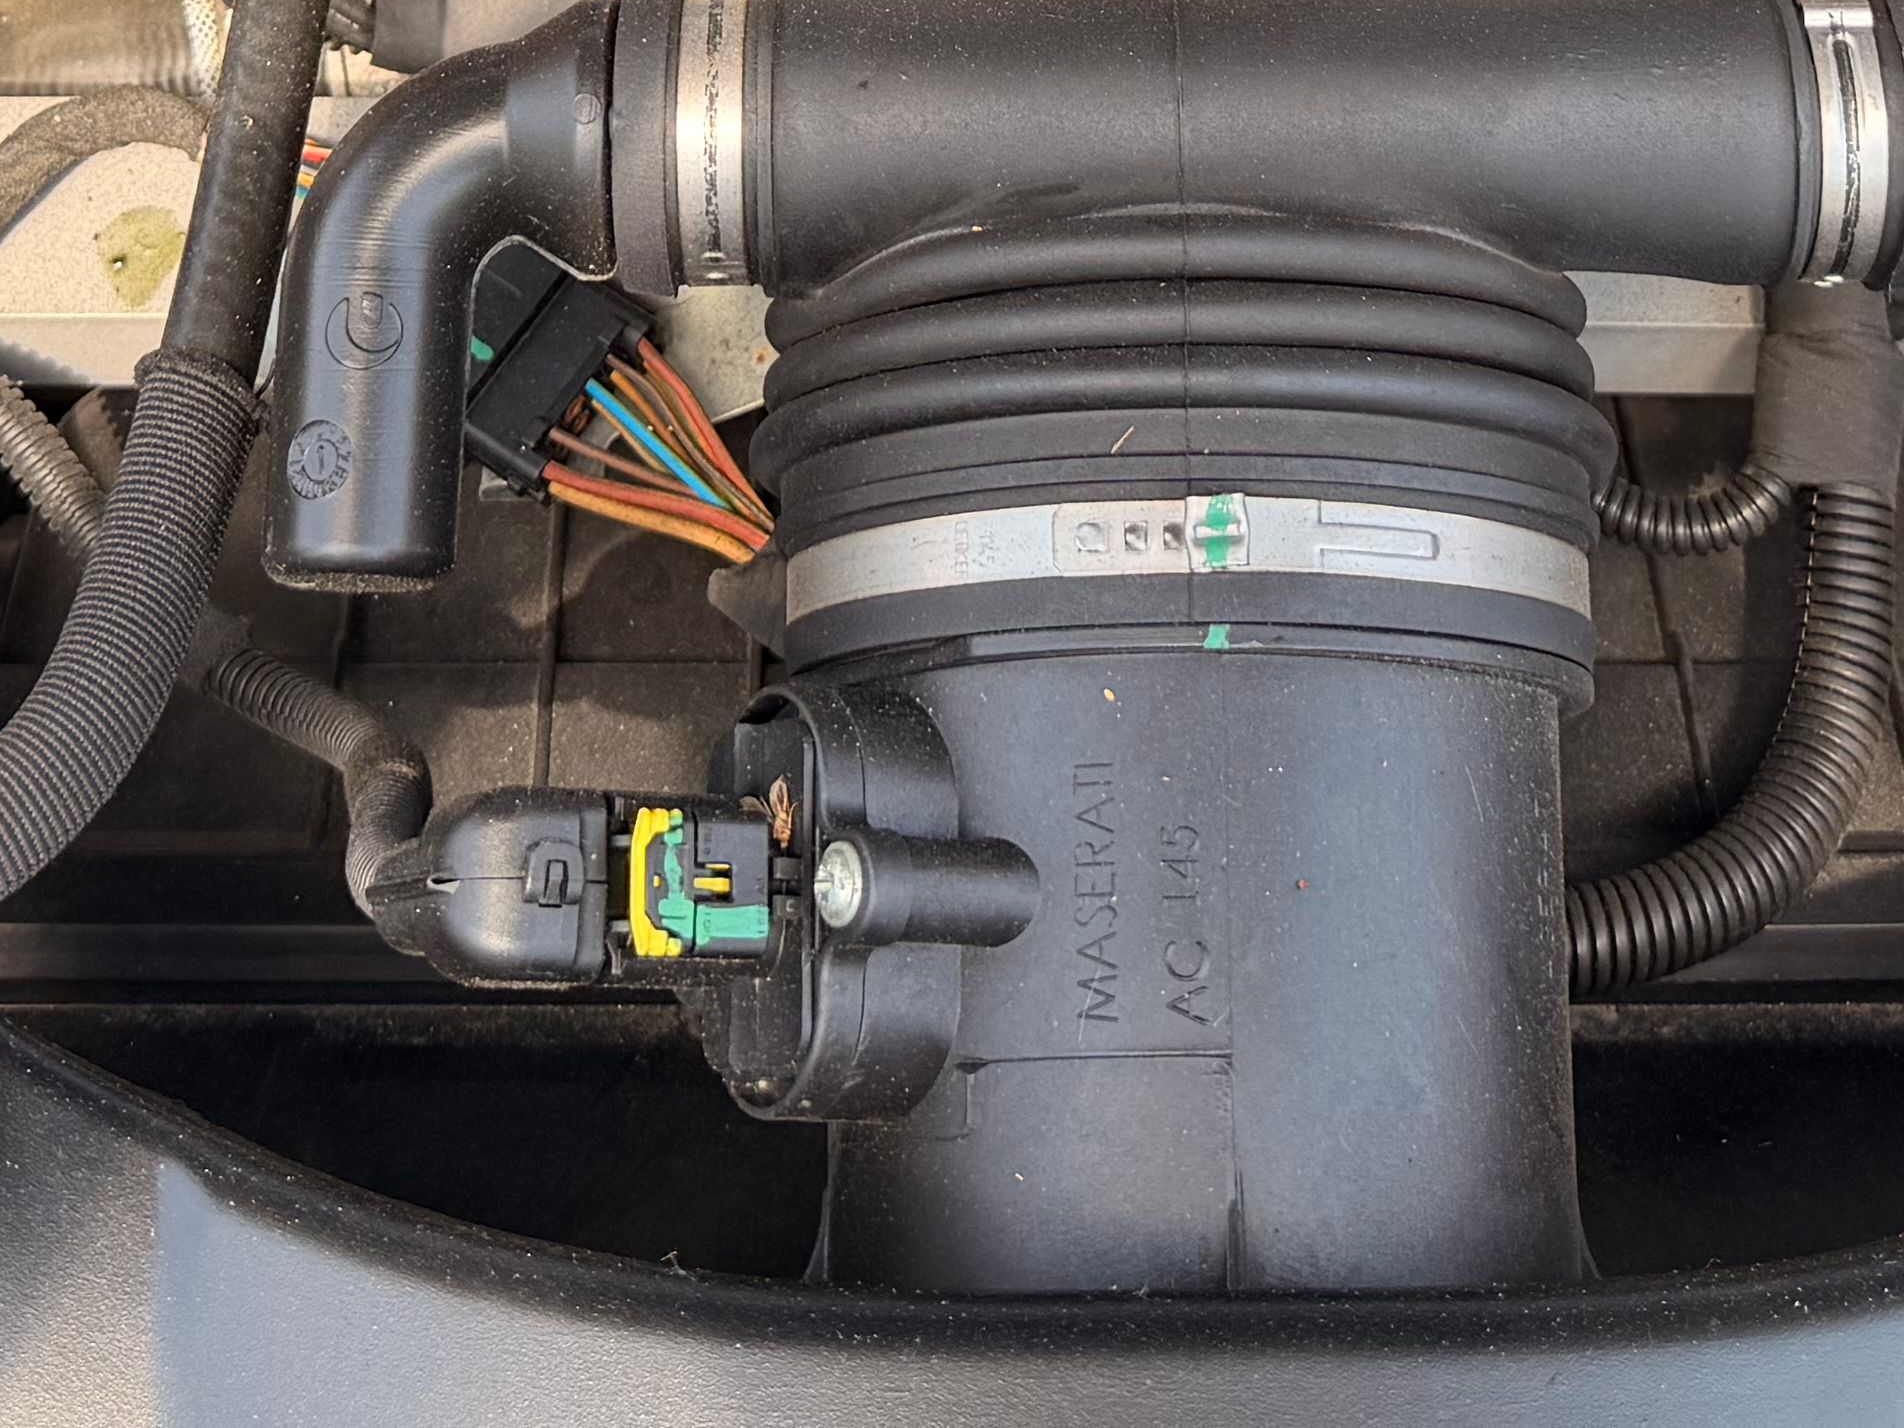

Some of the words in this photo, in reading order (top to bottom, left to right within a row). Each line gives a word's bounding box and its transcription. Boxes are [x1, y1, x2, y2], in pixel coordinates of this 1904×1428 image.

[1073, 761, 1119, 1024] MASERATI
[1160, 824, 1201, 906] 145
[1165, 939, 1211, 1027] AC
